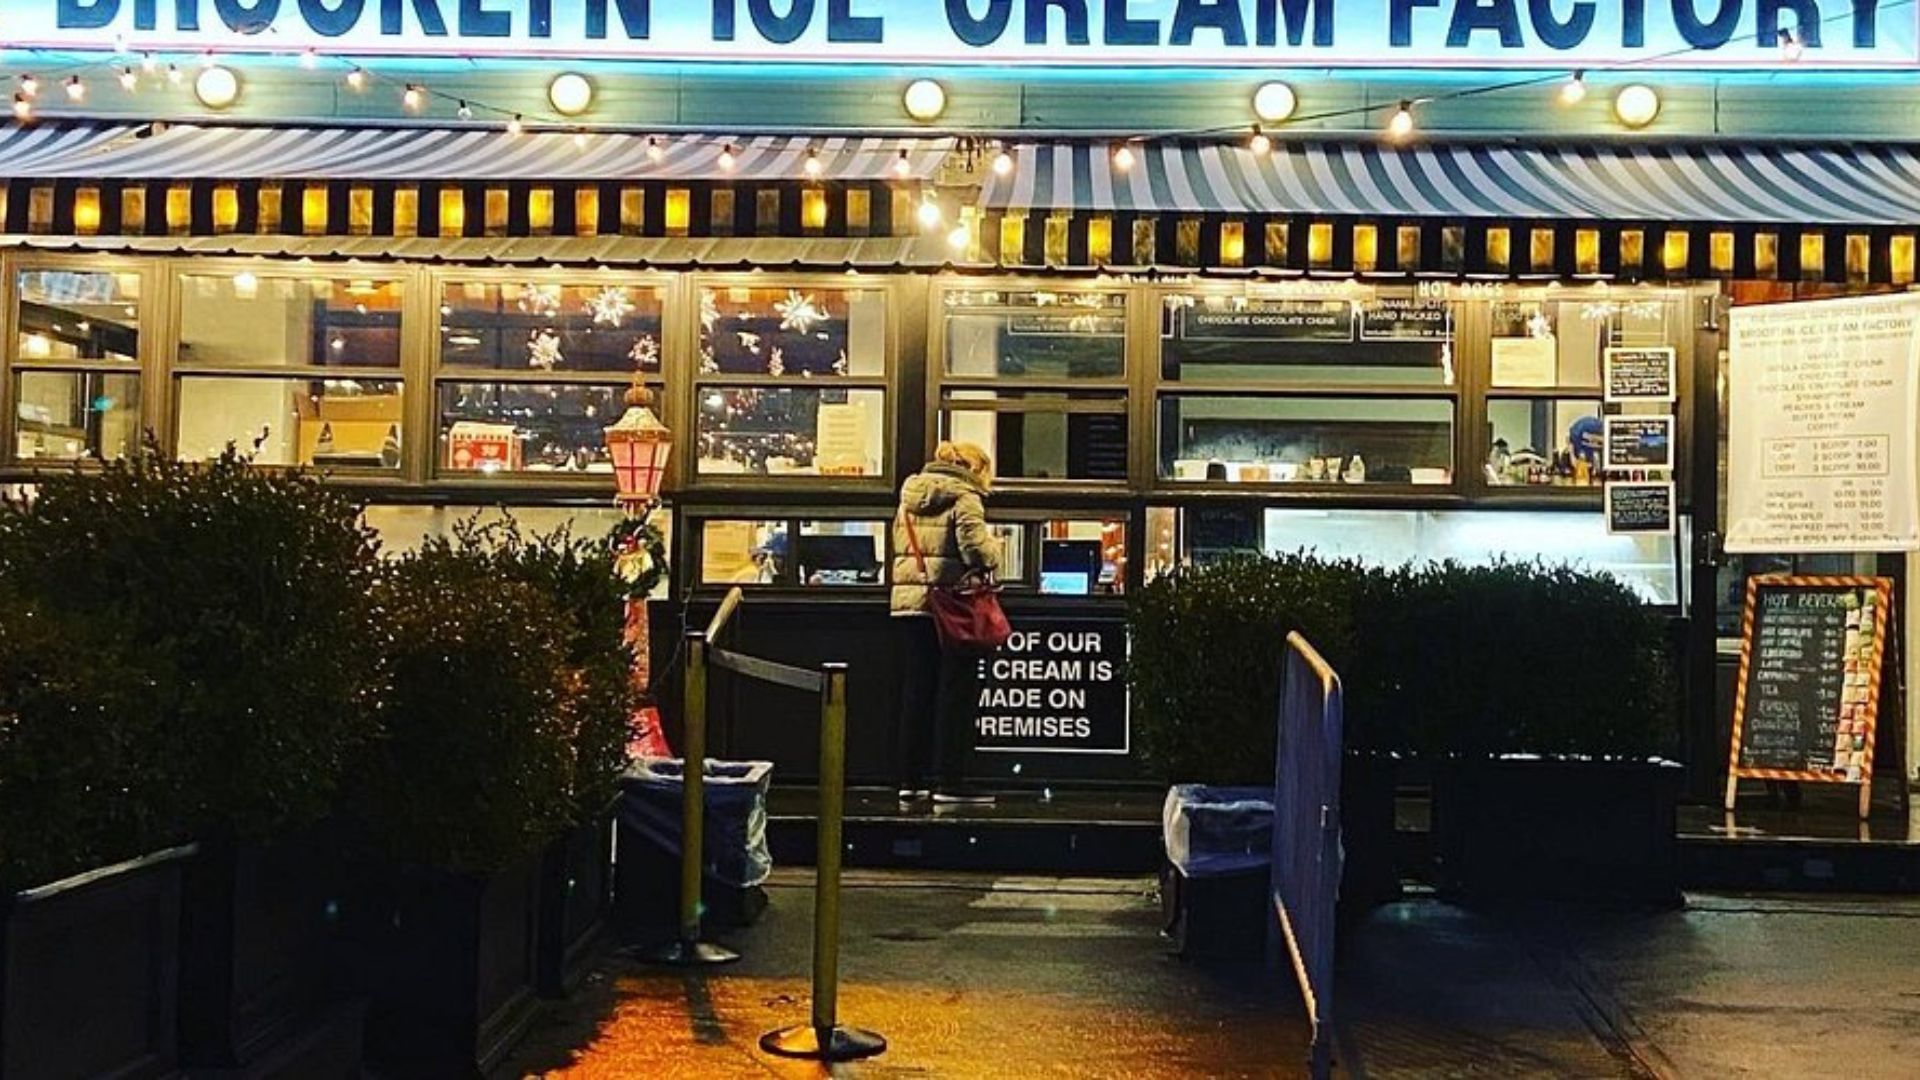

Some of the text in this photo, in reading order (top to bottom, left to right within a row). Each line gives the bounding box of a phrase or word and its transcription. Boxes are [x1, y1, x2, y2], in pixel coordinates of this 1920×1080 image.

[1418, 280, 1450, 298] HOT
[1368, 310, 1398, 321] HAND
[1400, 310, 1443, 321] PACKED
[1763, 592, 1837, 608] HOT BEVER
[1007, 631, 1101, 653] OF OUR
[992, 659, 1081, 681] CREAM
[1089, 660, 1113, 681] IS
[1048, 688, 1085, 709] ON
[975, 716, 1091, 737] REMISES
